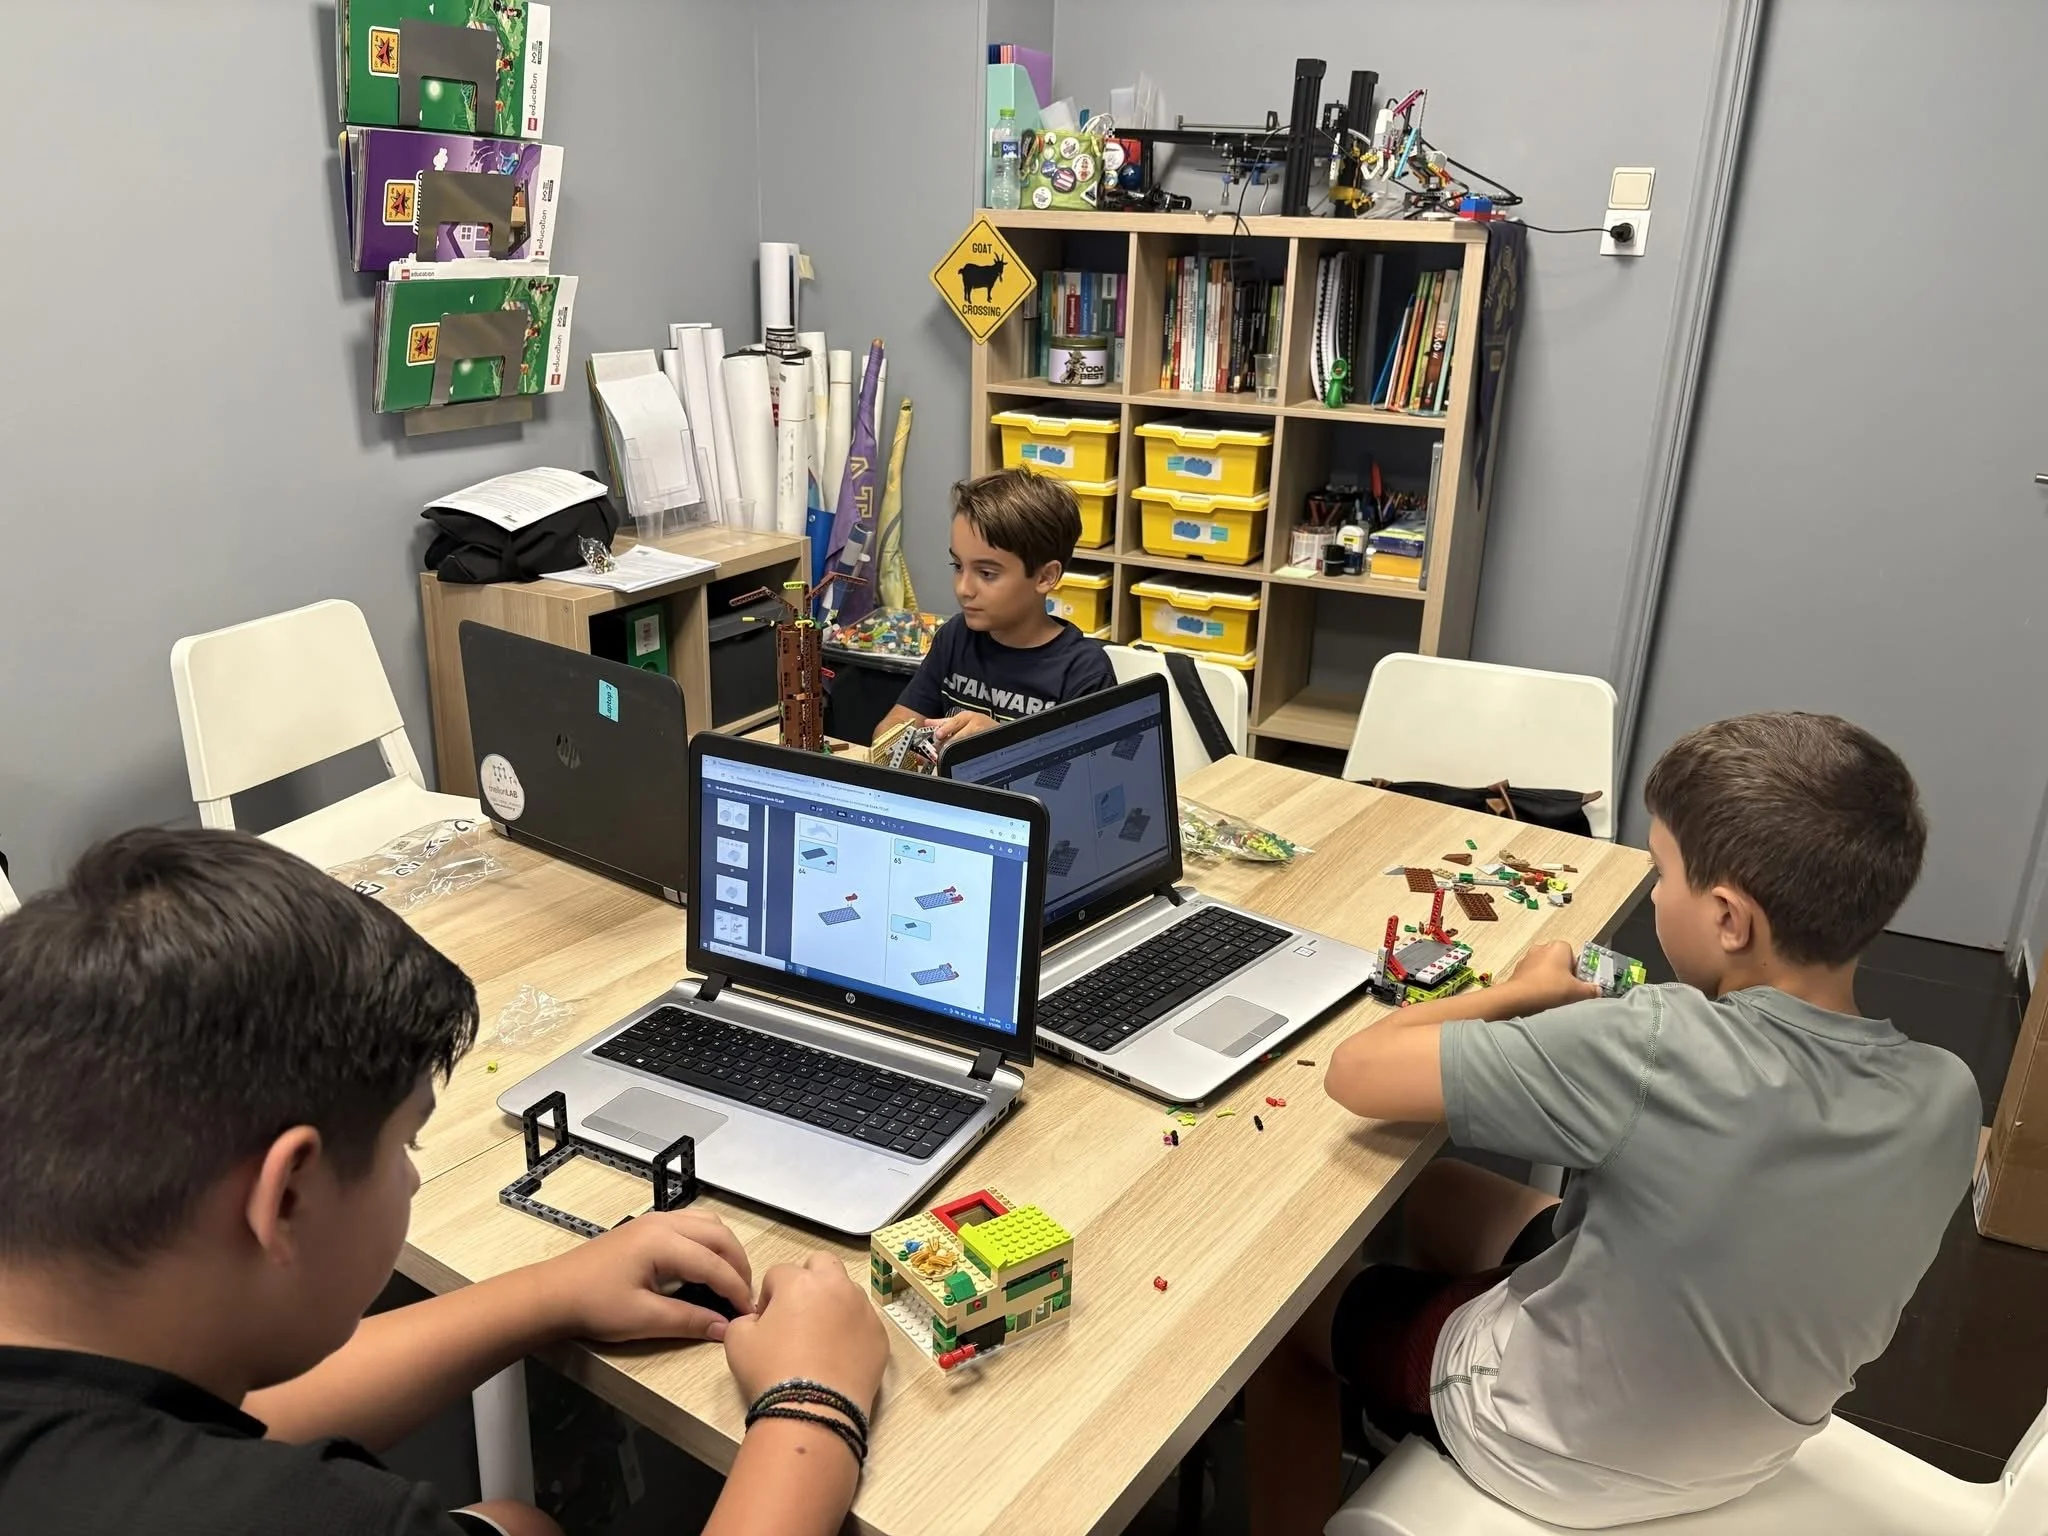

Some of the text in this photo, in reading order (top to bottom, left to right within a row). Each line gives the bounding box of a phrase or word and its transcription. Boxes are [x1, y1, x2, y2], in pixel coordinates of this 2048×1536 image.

[529, 73, 538, 116] education
[537, 209, 547, 249] education
[972, 243, 992, 254] GOAT
[962, 304, 1001, 317] CROSSING
[552, 334, 562, 373] education
[1079, 365, 1104, 373] YODA
